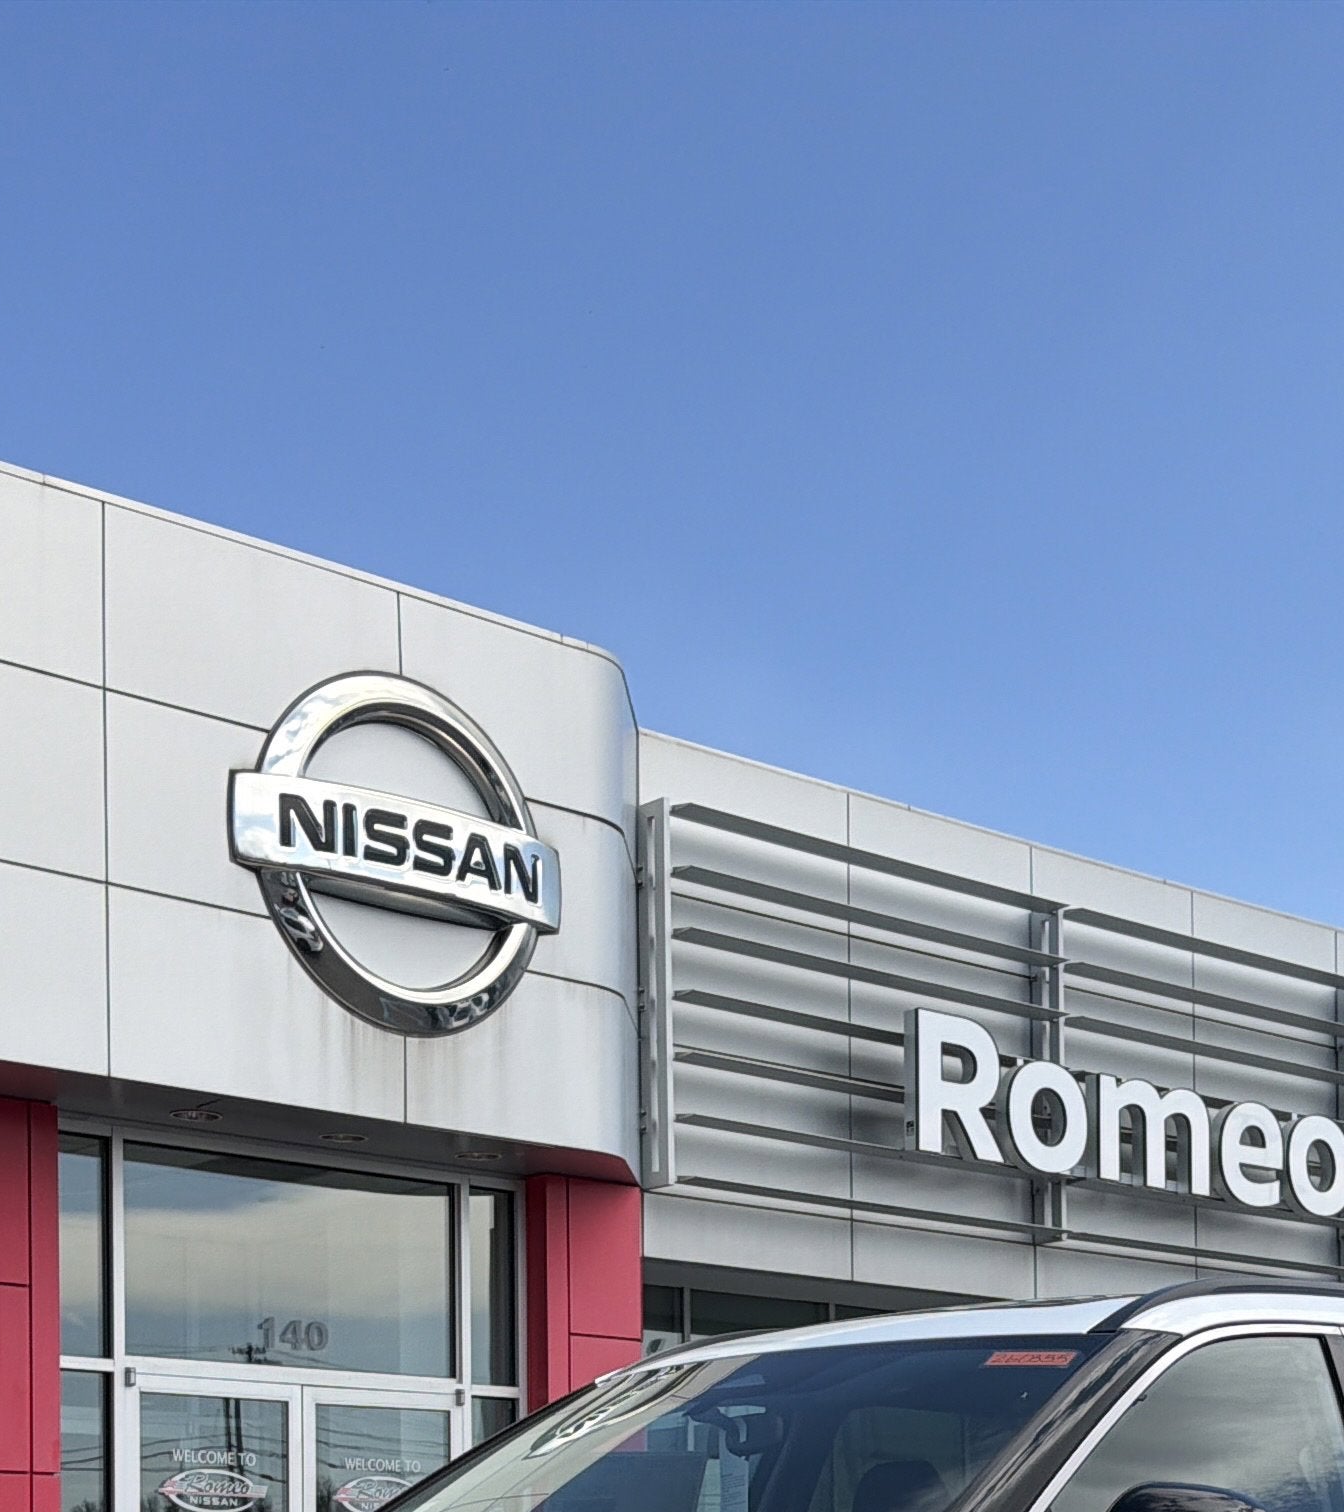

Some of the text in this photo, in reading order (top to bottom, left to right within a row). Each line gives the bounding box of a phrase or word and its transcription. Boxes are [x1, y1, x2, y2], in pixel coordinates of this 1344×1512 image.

[279, 793, 541, 905] NISSAN
[257, 1316, 328, 1351] 140
[172, 1449, 256, 1466] WELCOME TO
[345, 1457, 421, 1473] WELCOME TO
[183, 1472, 251, 1495] Romeo
[189, 1496, 239, 1507] NISSAN
